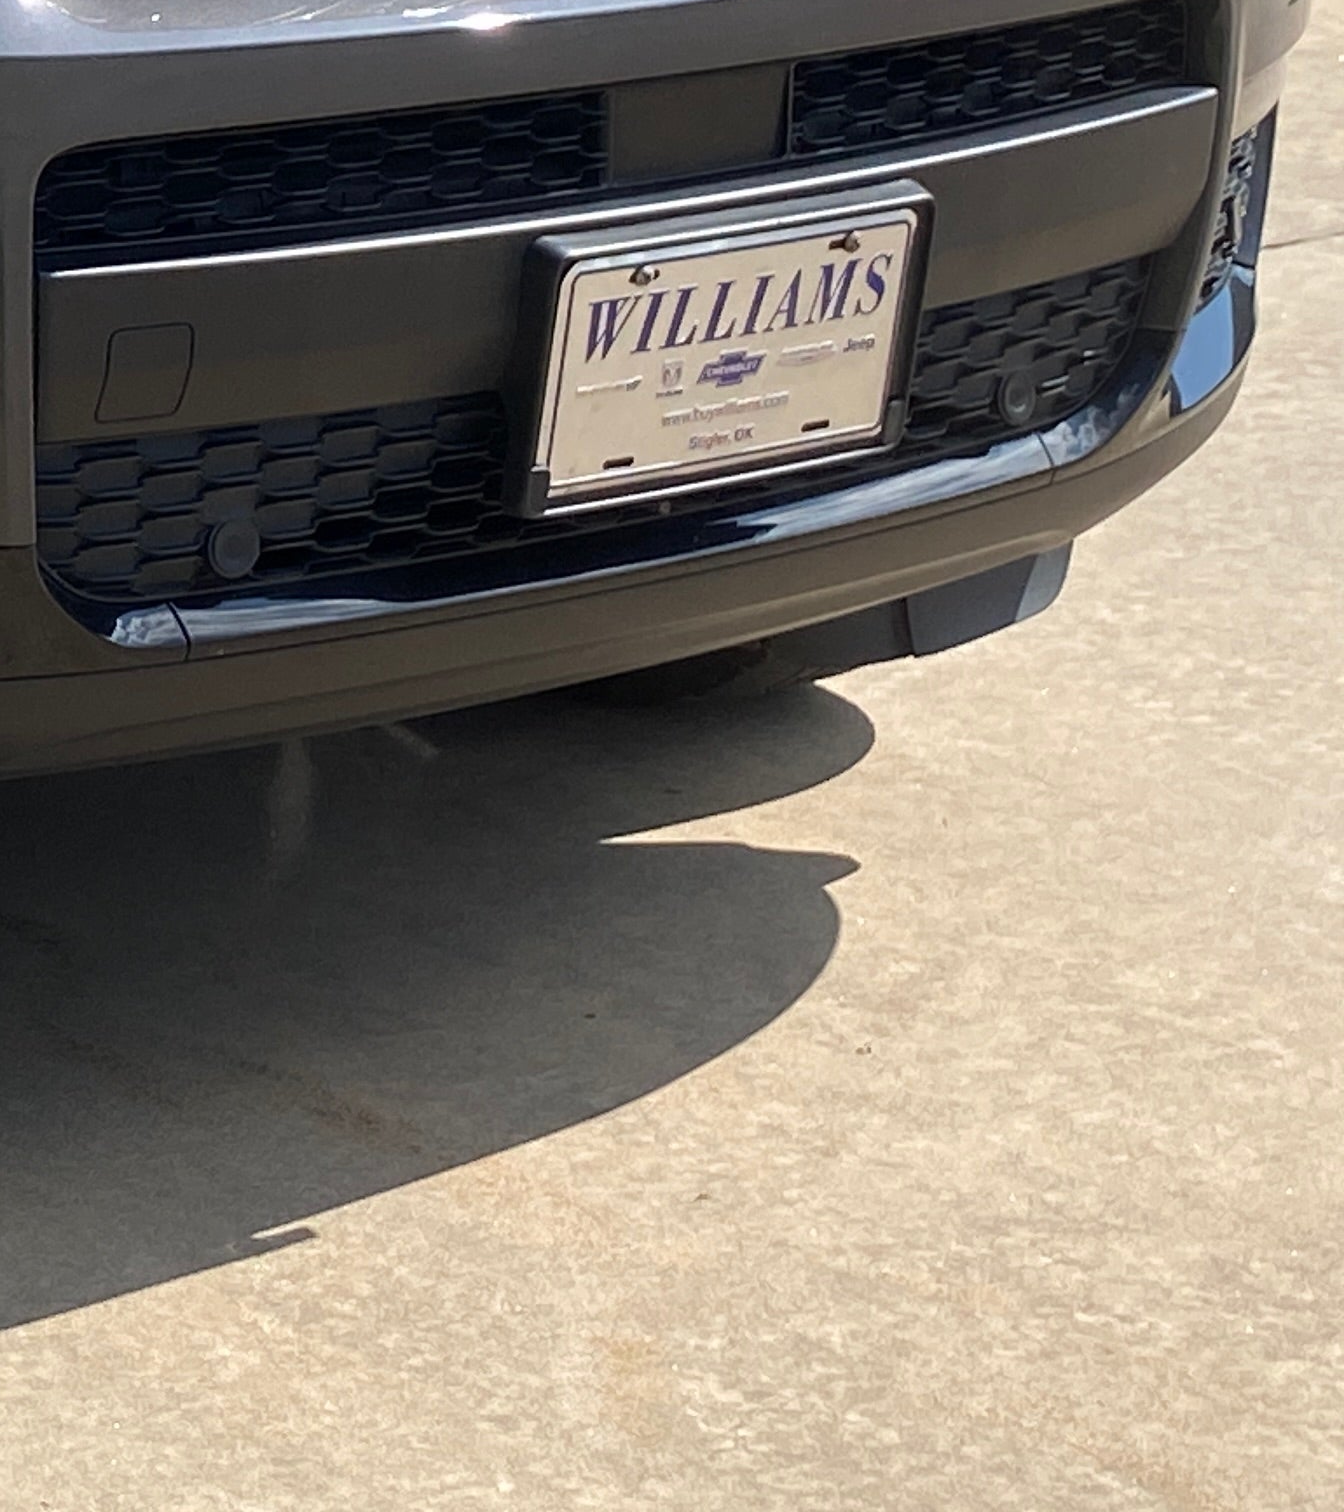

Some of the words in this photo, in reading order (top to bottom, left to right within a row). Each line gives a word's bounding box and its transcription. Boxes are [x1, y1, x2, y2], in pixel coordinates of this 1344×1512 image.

[584, 252, 894, 364] WILLIAMS
[842, 335, 876, 353] Jeep
[734, 424, 755, 442] OK
